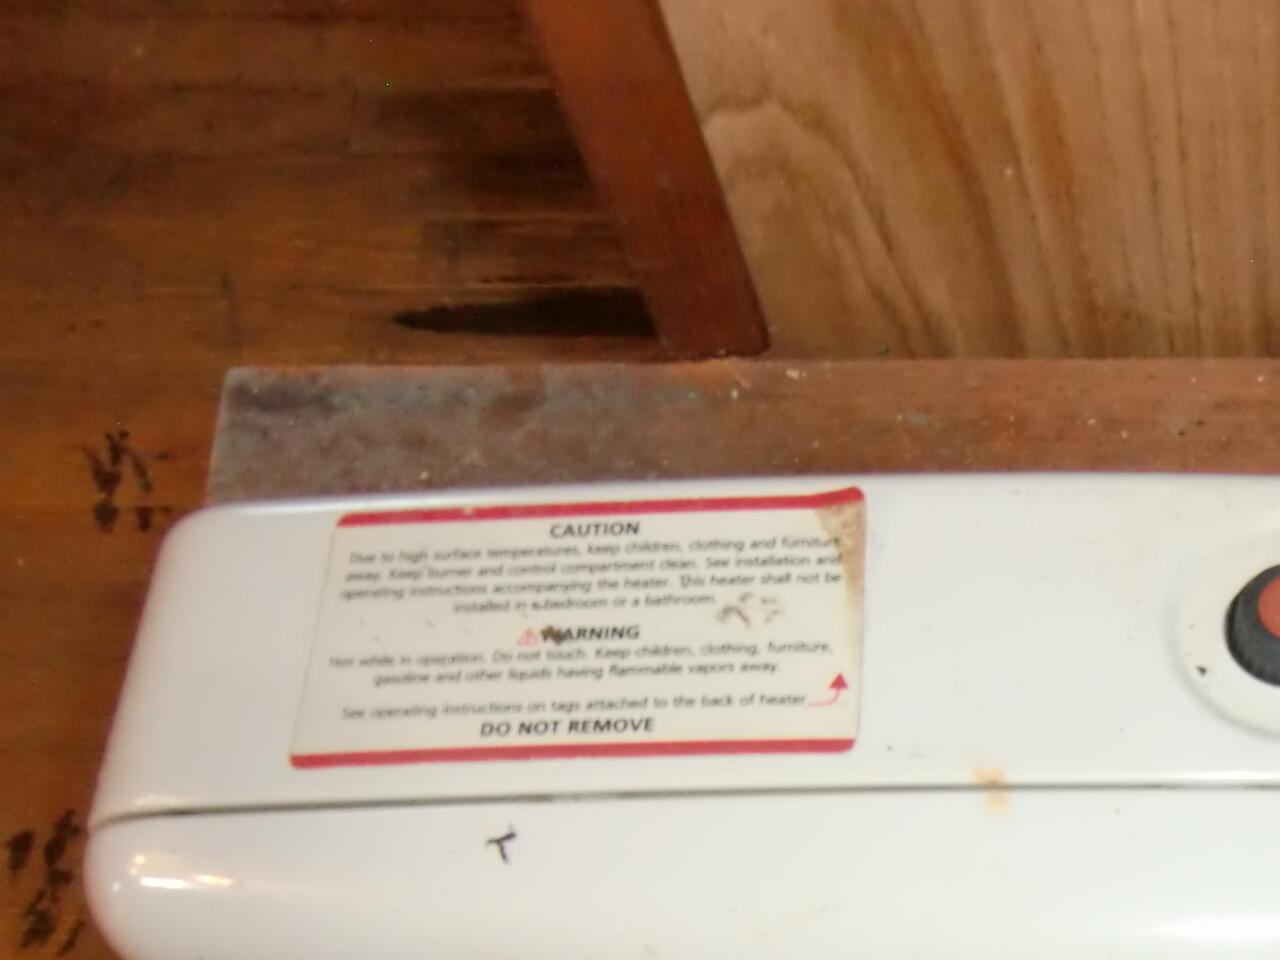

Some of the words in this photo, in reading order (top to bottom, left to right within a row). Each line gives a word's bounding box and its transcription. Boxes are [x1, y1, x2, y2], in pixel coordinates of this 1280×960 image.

[550, 521, 640, 538] CAUTION
[349, 550, 376, 563] Due
[400, 547, 428, 564] high
[433, 548, 481, 561] surface
[587, 543, 620, 555] keep
[688, 538, 744, 552] clothing
[749, 537, 776, 550] and
[477, 564, 503, 577] and
[507, 562, 556, 576] control
[561, 557, 654, 575] compartment
[705, 556, 730, 568] See
[735, 553, 810, 568] installation
[339, 586, 404, 601] operating
[410, 582, 487, 597] instructions
[493, 580, 592, 596] accompanying
[597, 577, 620, 590] the
[710, 573, 754, 587] heater
[760, 572, 791, 585] shall
[797, 572, 819, 584] not
[825, 571, 842, 583] be
[453, 599, 510, 613] installed
[492, 651, 512, 663] Do
[516, 650, 540, 662] not
[595, 646, 631, 659] Keep
[435, 670, 461, 683] and
[465, 669, 503, 682] other
[557, 665, 603, 680] having
[608, 662, 683, 677] flammable
[688, 662, 734, 675] vapors
[342, 706, 365, 719] See
[370, 704, 437, 719] operating
[442, 701, 521, 715] instructions
[527, 702, 547, 713] on
[551, 699, 580, 713] tags
[586, 697, 648, 710] attached
[653, 697, 667, 709] to
[673, 695, 696, 708] the
[701, 694, 732, 707] back
[739, 693, 755, 706] of
[759, 694, 806, 706] heater
[480, 721, 510, 737] DO
[518, 719, 561, 736] NOT
[568, 717, 654, 735] REMOVE
